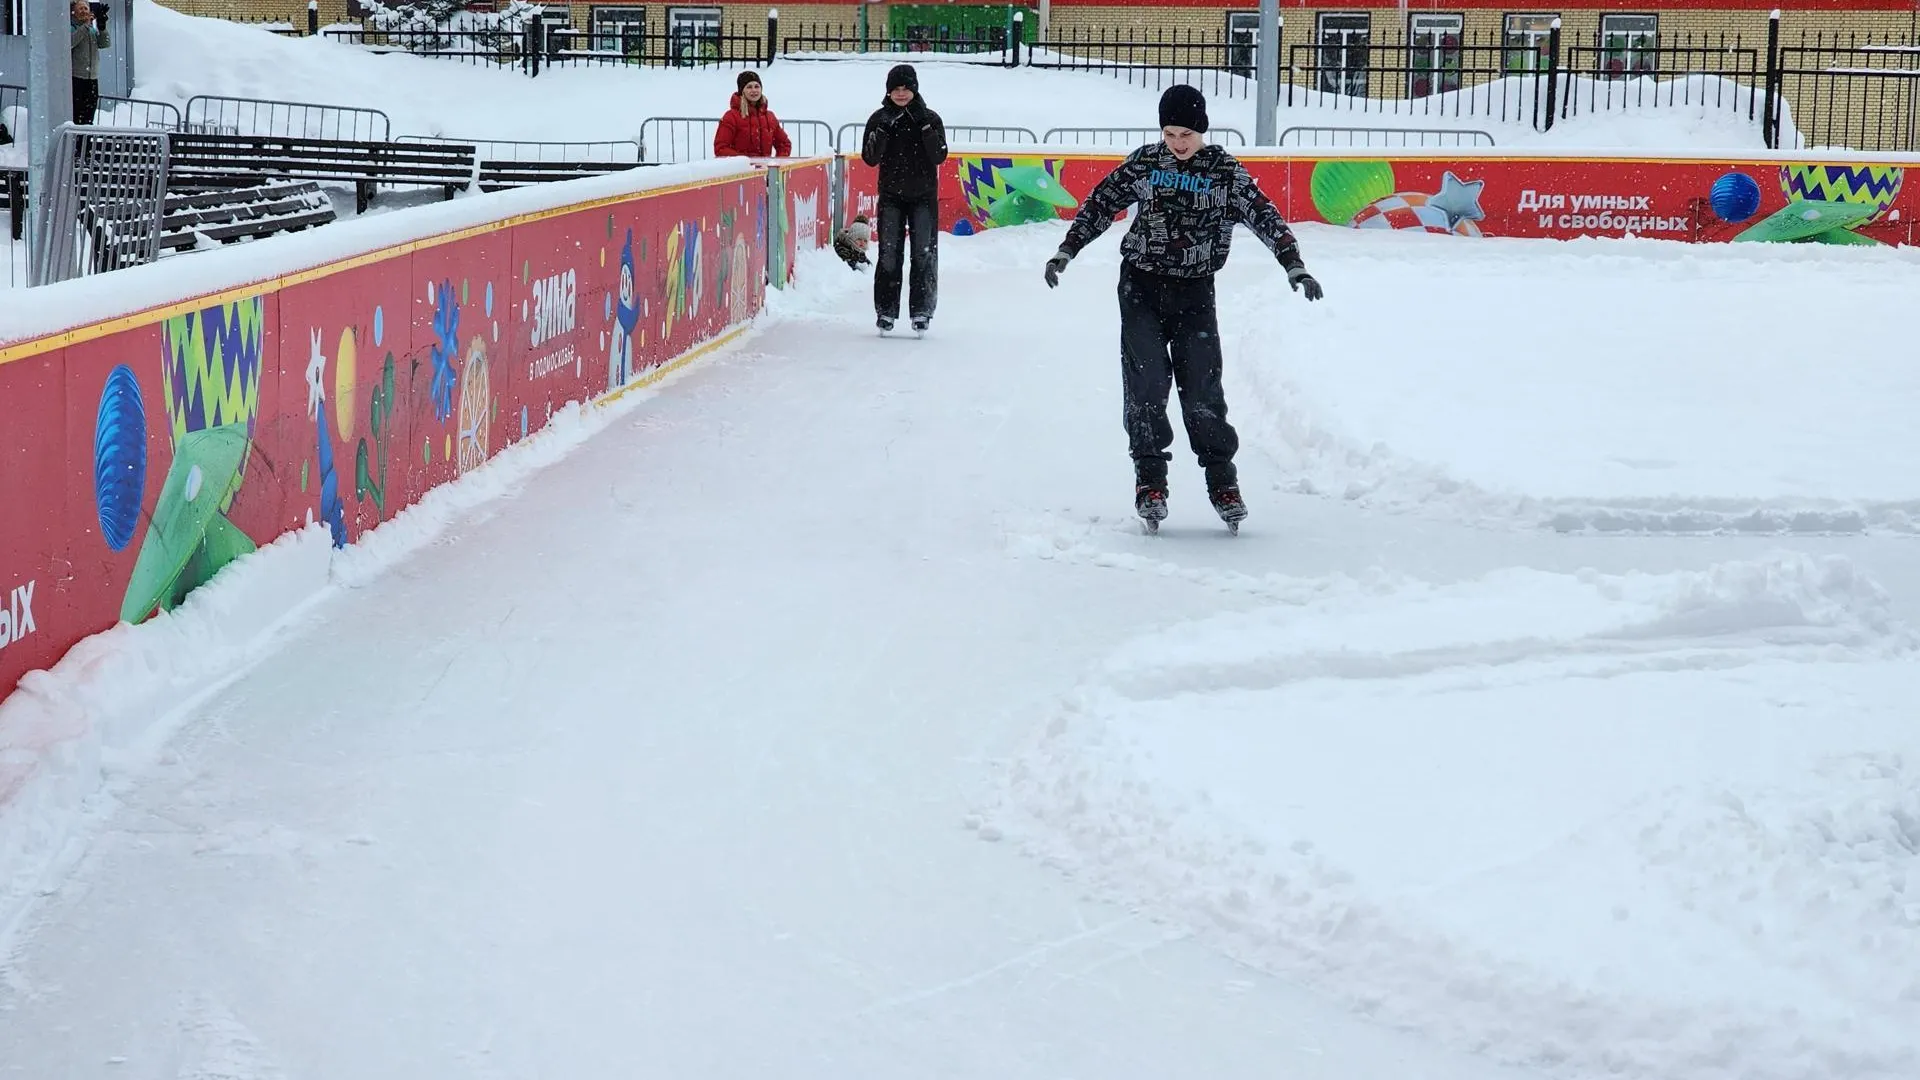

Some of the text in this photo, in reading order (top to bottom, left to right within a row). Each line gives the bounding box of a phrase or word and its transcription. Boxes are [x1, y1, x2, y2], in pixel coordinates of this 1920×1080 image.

[1151, 169, 1213, 195] DISTRICT
[1518, 189, 1650, 213] Для умных
[1538, 210, 1689, 233] и свободных
